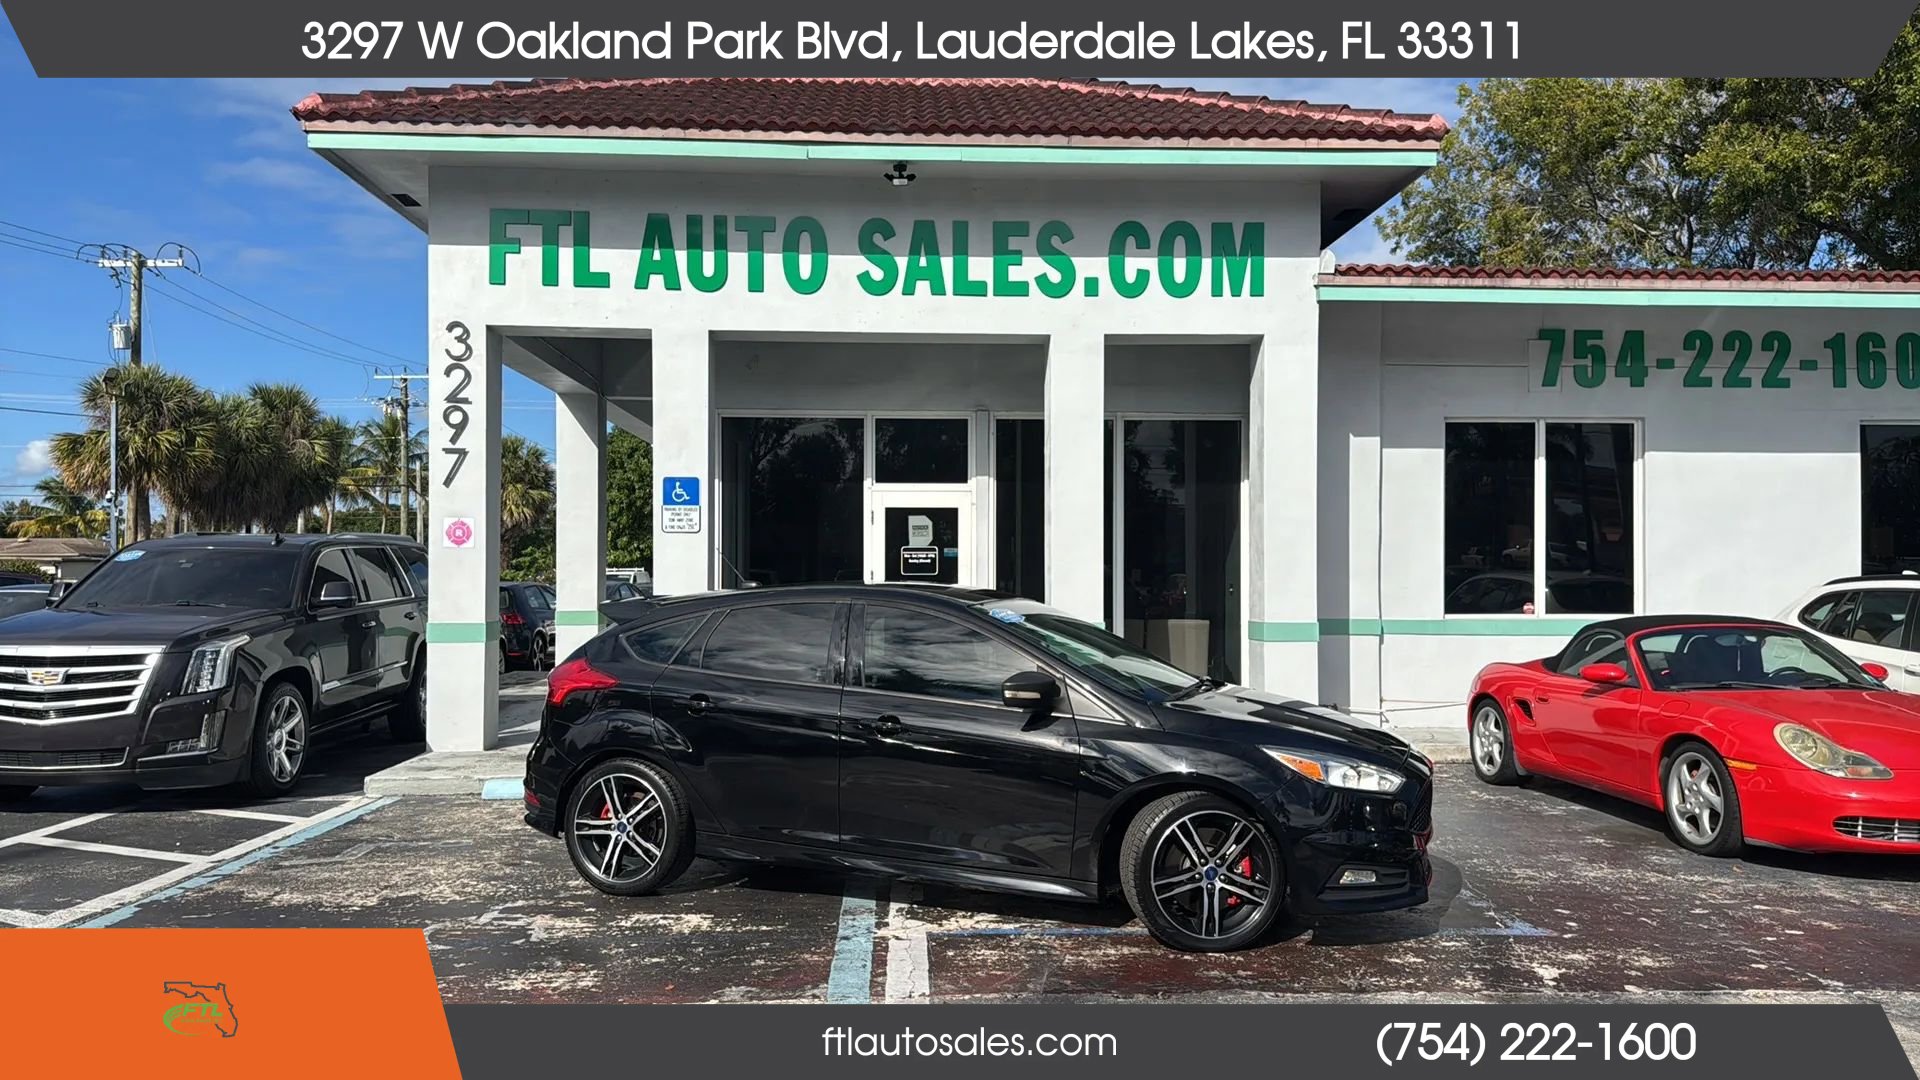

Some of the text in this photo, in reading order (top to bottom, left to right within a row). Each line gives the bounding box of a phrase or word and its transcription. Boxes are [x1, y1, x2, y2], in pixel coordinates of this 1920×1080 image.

[489, 209, 1266, 299] FTL AUTO SALES.COM
[442, 321, 473, 489] 3297
